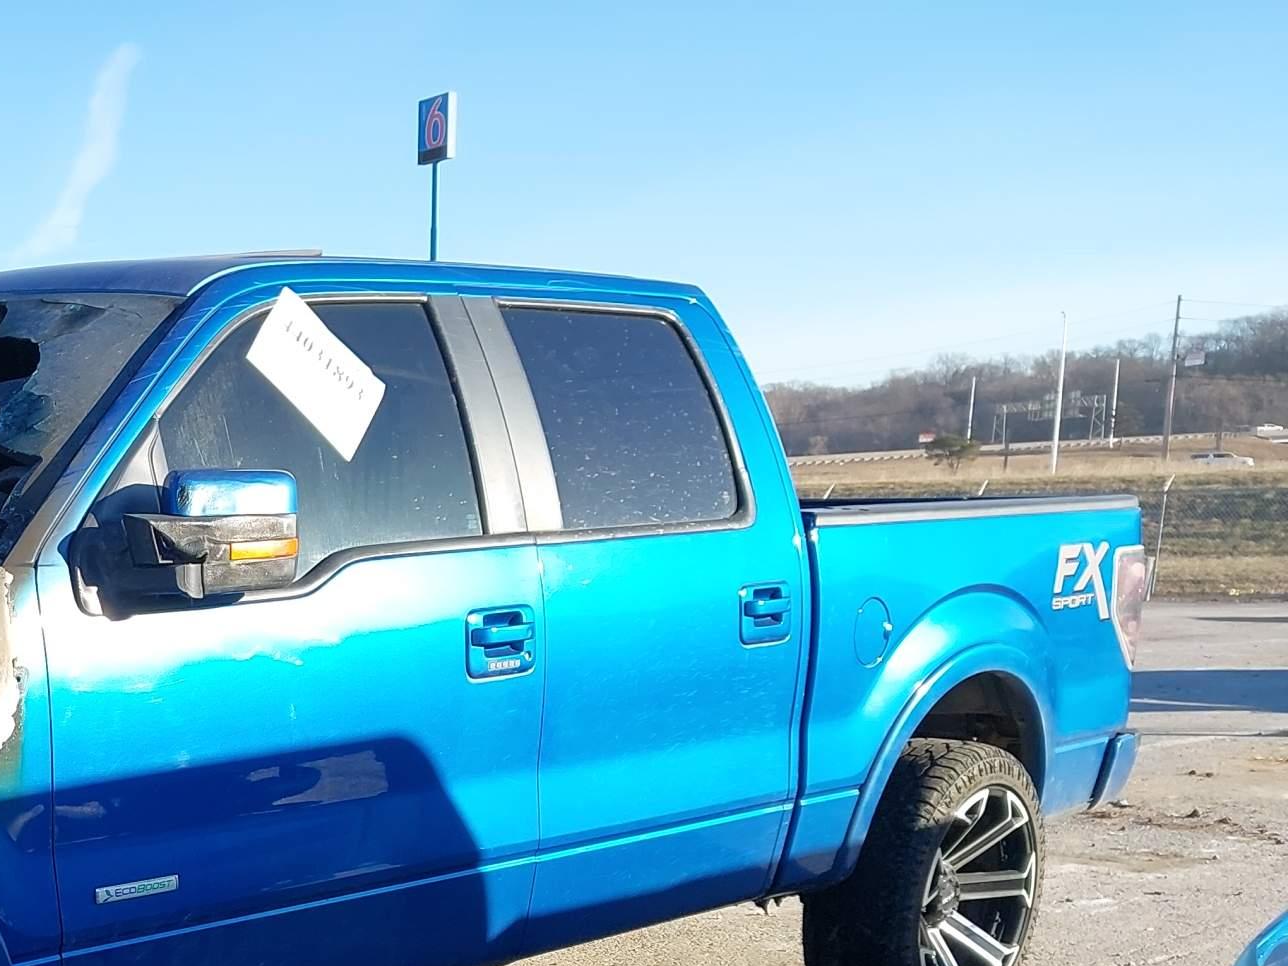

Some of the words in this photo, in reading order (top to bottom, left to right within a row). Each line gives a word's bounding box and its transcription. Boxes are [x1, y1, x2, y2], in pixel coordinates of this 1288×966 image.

[425, 95, 446, 149] 6
[1052, 593, 1095, 611] SPORT
[1053, 540, 1110, 620] FX
